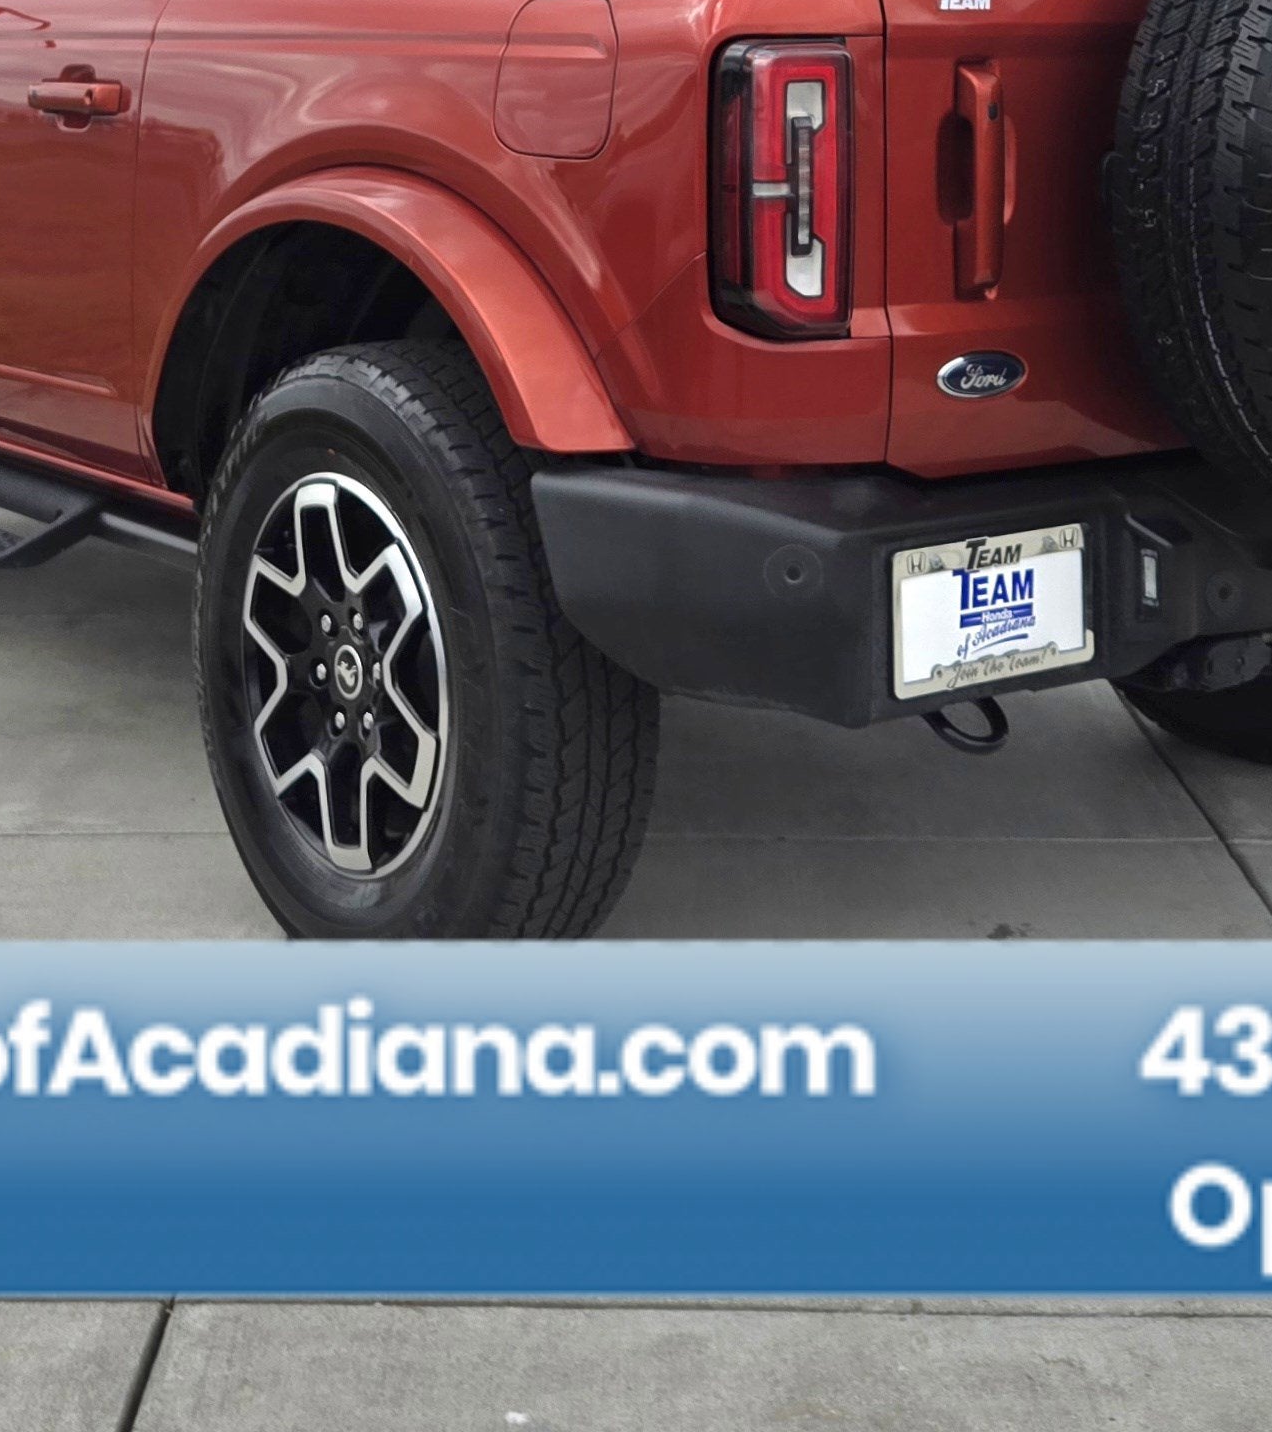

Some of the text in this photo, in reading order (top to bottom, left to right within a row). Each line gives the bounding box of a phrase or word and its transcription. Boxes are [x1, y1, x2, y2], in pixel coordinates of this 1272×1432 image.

[960, 363, 1008, 389] Ford
[965, 538, 1023, 571] TEAM
[952, 568, 1035, 611] TEAM
[980, 607, 1014, 623] Honda
[956, 615, 1037, 660] of Acadiana
[947, 660, 978, 689] Join
